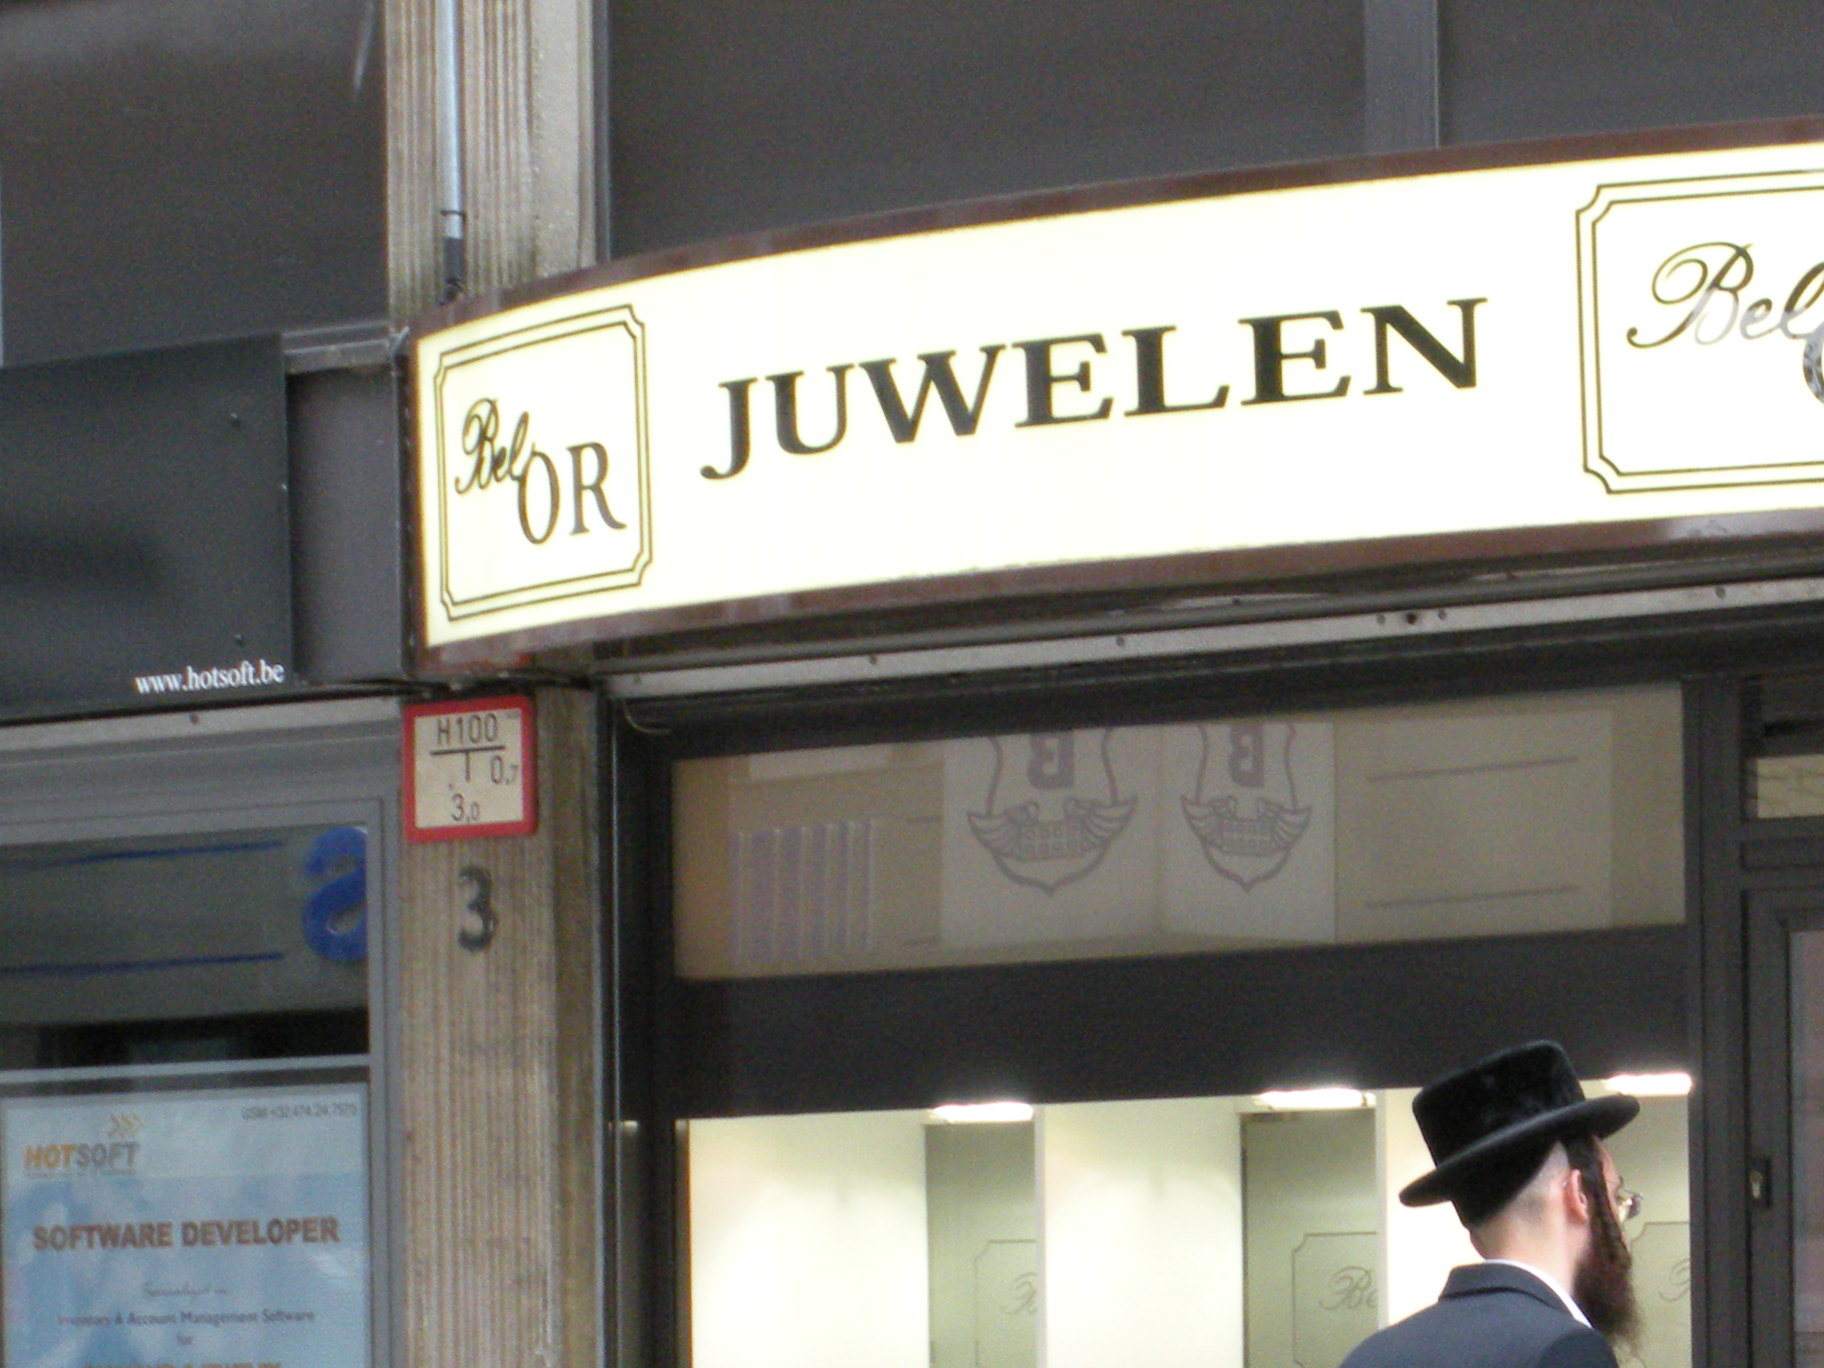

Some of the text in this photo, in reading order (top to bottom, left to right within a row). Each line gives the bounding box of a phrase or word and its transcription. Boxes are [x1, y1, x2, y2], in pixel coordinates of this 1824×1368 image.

[700, 299, 1487, 480] JUWELEN
[455, 398, 627, 544] Bel OR
[135, 660, 285, 695] www.hotsoft.be
[437, 713, 498, 744] H100
[457, 865, 495, 951] 3
[23, 1142, 140, 1170] HOTSOFT
[33, 1216, 340, 1250] SOFTWARE DEVELOPER
